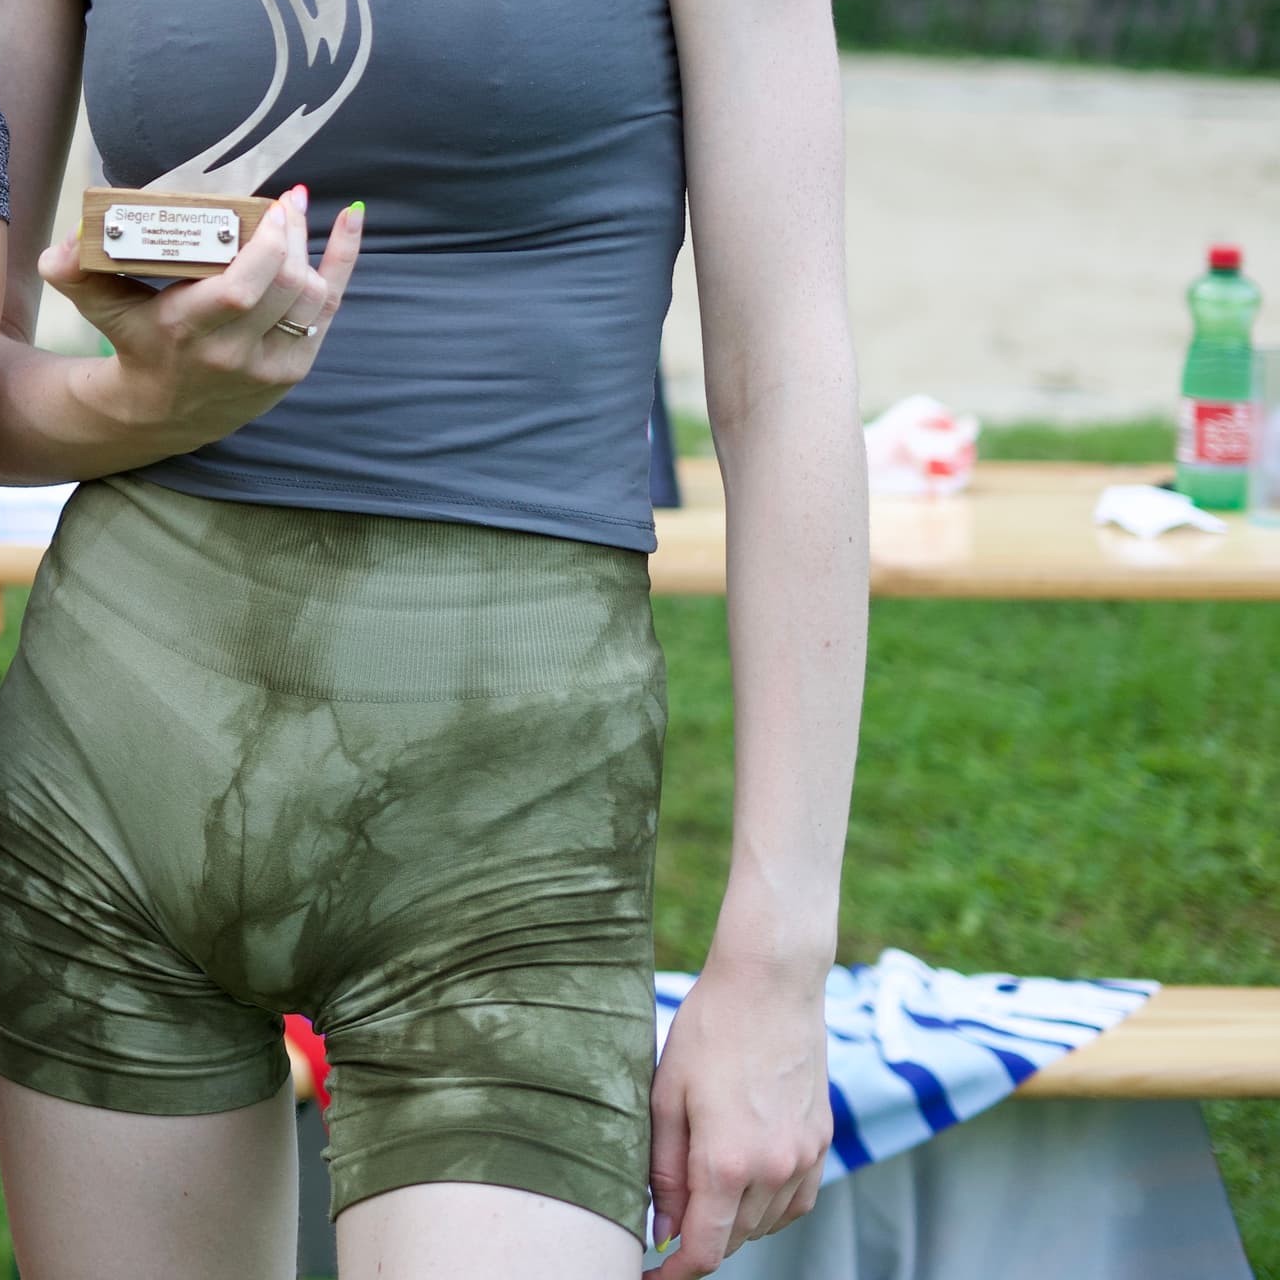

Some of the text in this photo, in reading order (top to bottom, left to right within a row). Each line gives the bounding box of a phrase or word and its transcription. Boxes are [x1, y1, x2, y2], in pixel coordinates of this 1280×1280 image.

[115, 208, 229, 226] Sieger Barwertung
[141, 227, 202, 237] Beachvolleyball
